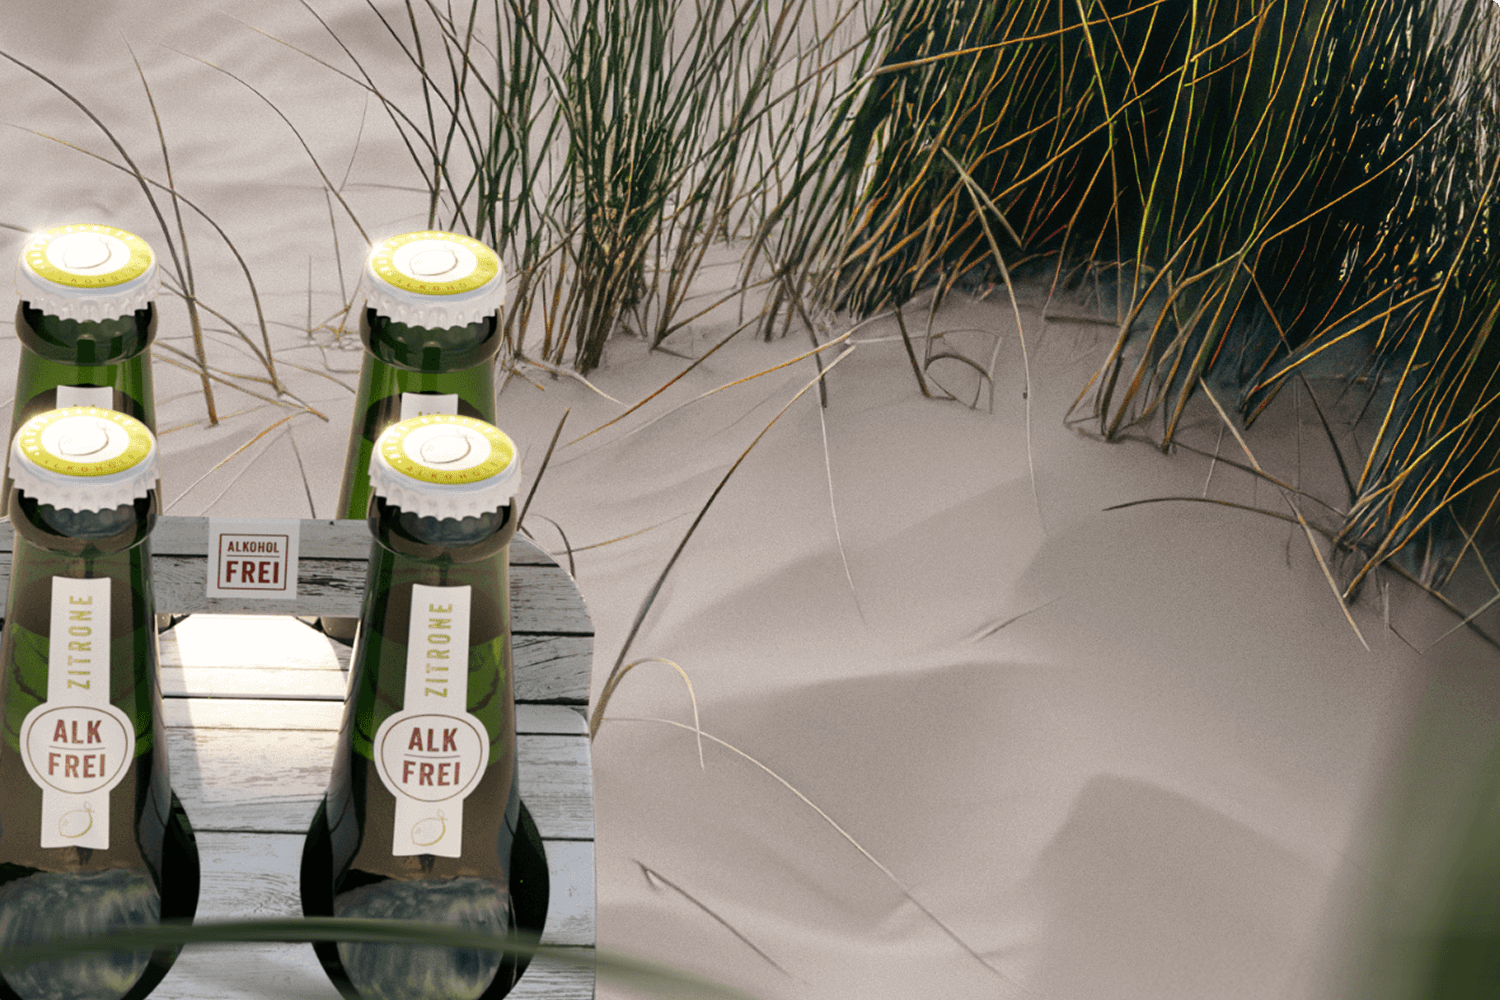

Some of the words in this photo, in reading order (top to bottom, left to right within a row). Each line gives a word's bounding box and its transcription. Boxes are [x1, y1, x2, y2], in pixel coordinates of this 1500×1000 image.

[227, 541, 279, 553] ALKOHOL
[226, 561, 279, 583] FREI
[67, 594, 93, 690] ZITRONE
[425, 603, 453, 698] ZITRONE
[53, 719, 102, 744] ALK
[408, 727, 458, 753] ALK
[47, 752, 106, 779] FREI
[402, 761, 460, 786] FREI
